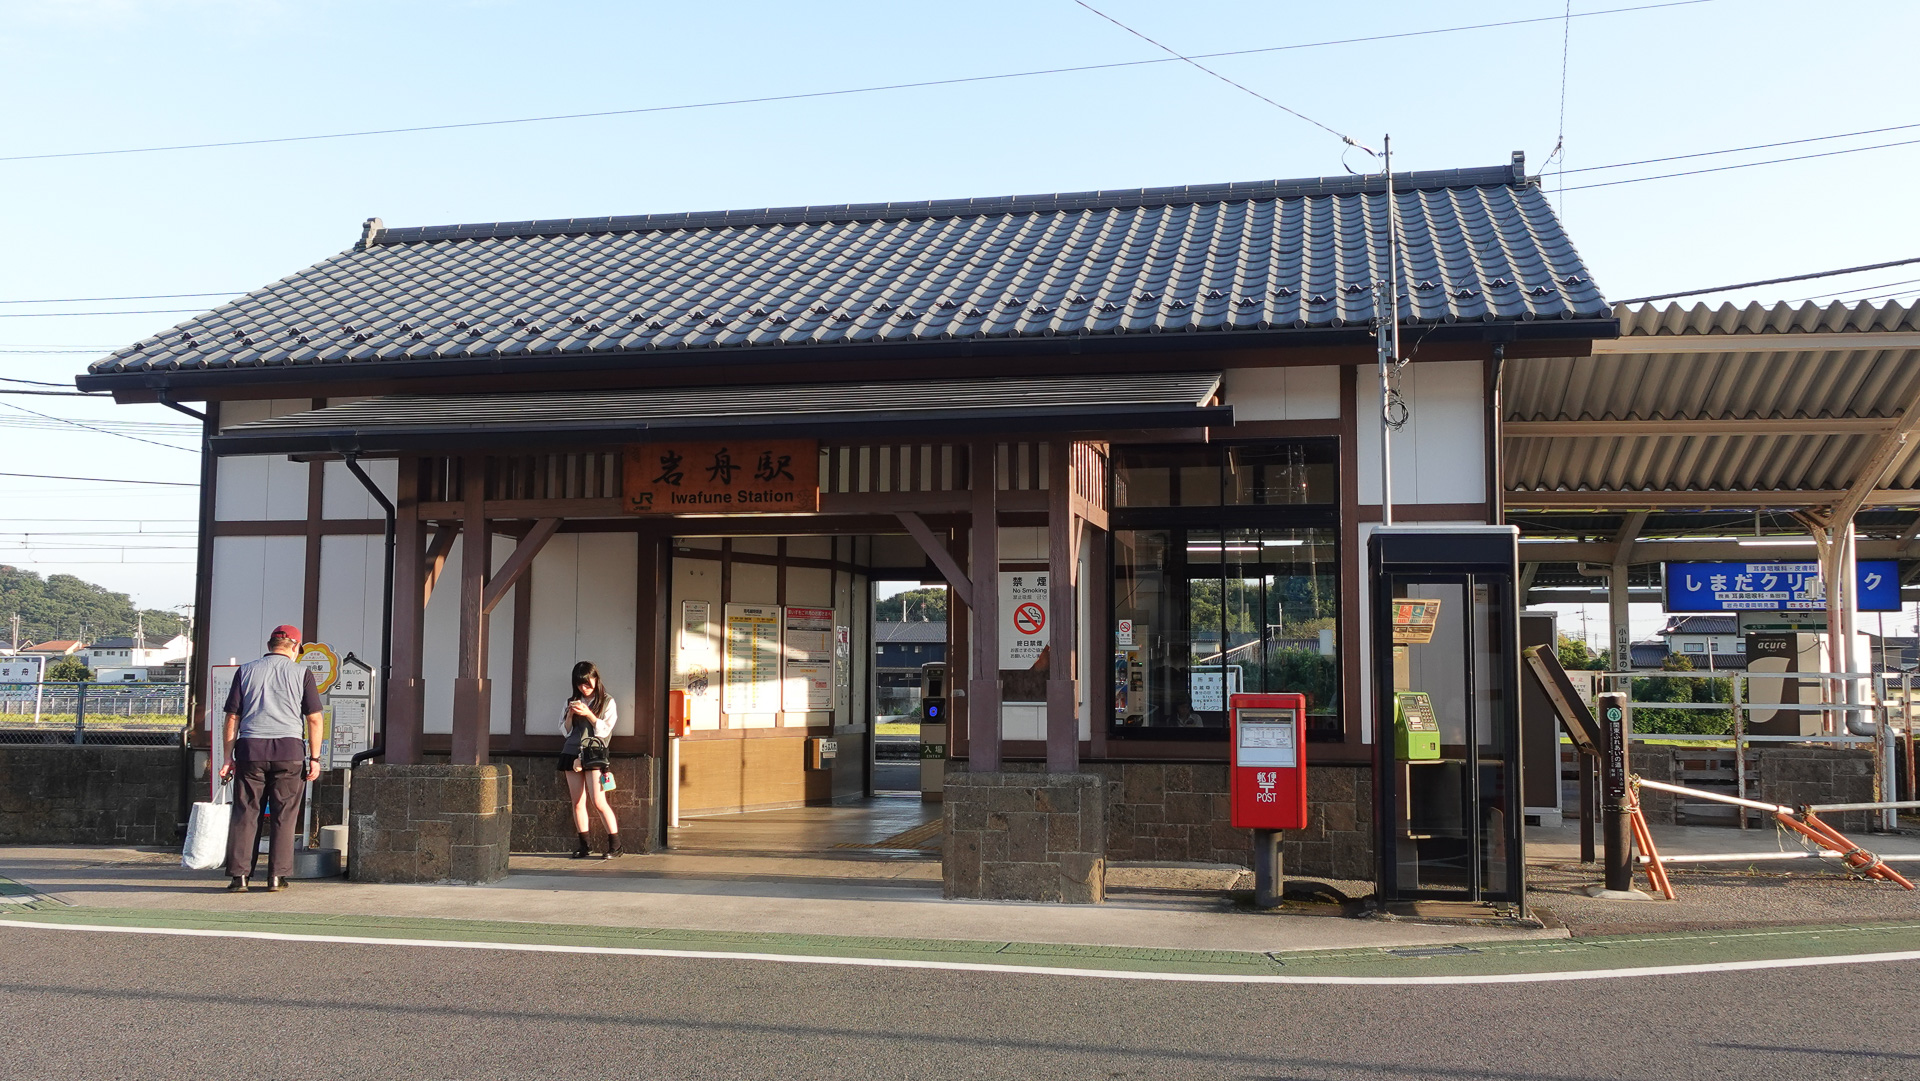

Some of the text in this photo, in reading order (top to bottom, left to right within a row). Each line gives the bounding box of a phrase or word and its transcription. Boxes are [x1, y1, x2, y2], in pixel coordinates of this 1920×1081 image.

[652, 447, 795, 486] 岩舟駅
[632, 493, 653, 505] JR
[671, 490, 793, 504] Iwafune Station
[1013, 577, 1046, 586] 禁煙
[1685, 572, 1882, 592] しまだクリク
[1757, 641, 1788, 650] acure
[924, 745, 943, 754] 入場
[1256, 771, 1277, 783] 郵便
[1256, 792, 1277, 803] POST
